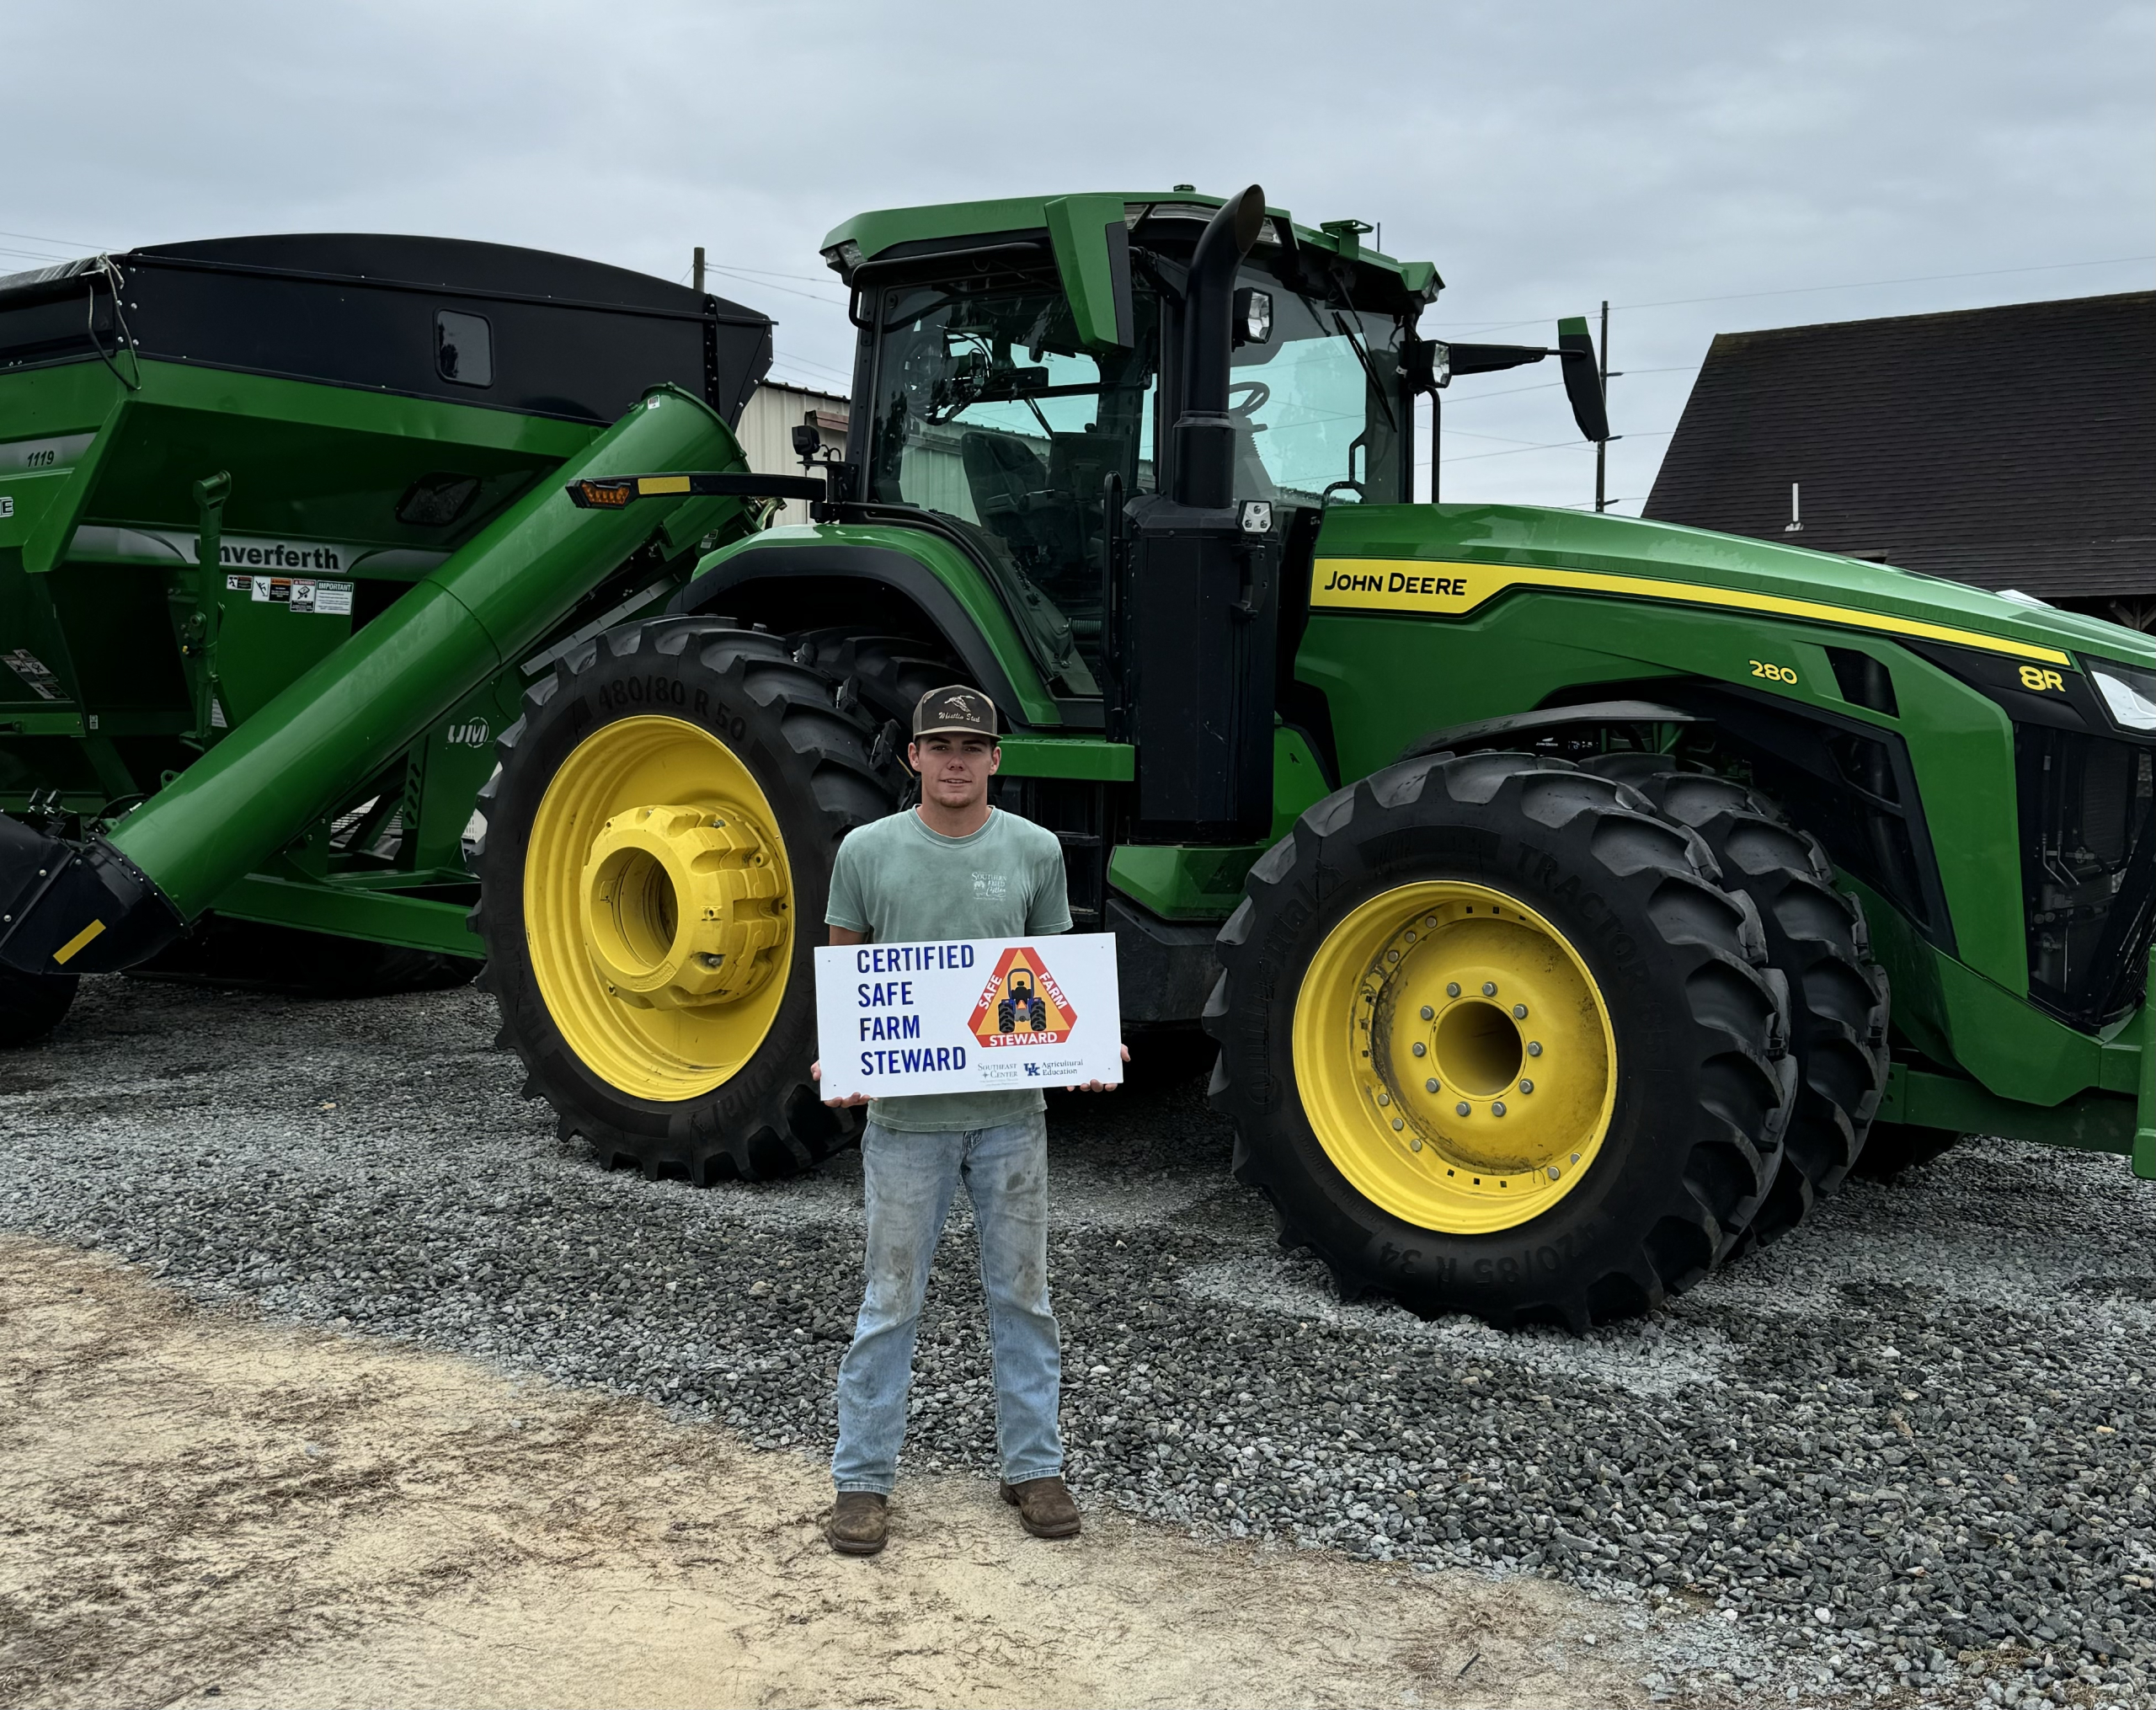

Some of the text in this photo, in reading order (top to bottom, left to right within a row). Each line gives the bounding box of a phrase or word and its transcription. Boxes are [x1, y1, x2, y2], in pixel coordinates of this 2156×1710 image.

[27, 450, 55, 468] 1119
[318, 582, 351, 591] IMPORTANT
[1324, 570, 1468, 596] JOHN DEERE
[1748, 659, 1798, 686] 280
[2018, 665, 2066, 692] 8R
[599, 674, 747, 742] 480/80 R 50
[1517, 841, 1652, 986] TRACTOR
[857, 943, 974, 974] CERTIFIED
[857, 981, 915, 1008] SAFE
[979, 974, 1003, 1011] SAFE
[1038, 971, 1068, 1010] FARM
[860, 1014, 921, 1042] FARM
[989, 1031, 1058, 1047] STEWARD
[861, 1045, 967, 1077] STEWARD
[977, 1062, 1018, 1071] SOUTHEAST
[990, 1070, 1018, 1079] CENTER
[1023, 1062, 1041, 1077] UK
[1041, 1058, 1084, 1069] Agricultural
[1043, 1068, 1078, 1077] Education
[1379, 1241, 1422, 1274] 34
[1435, 1254, 1458, 1290] R
